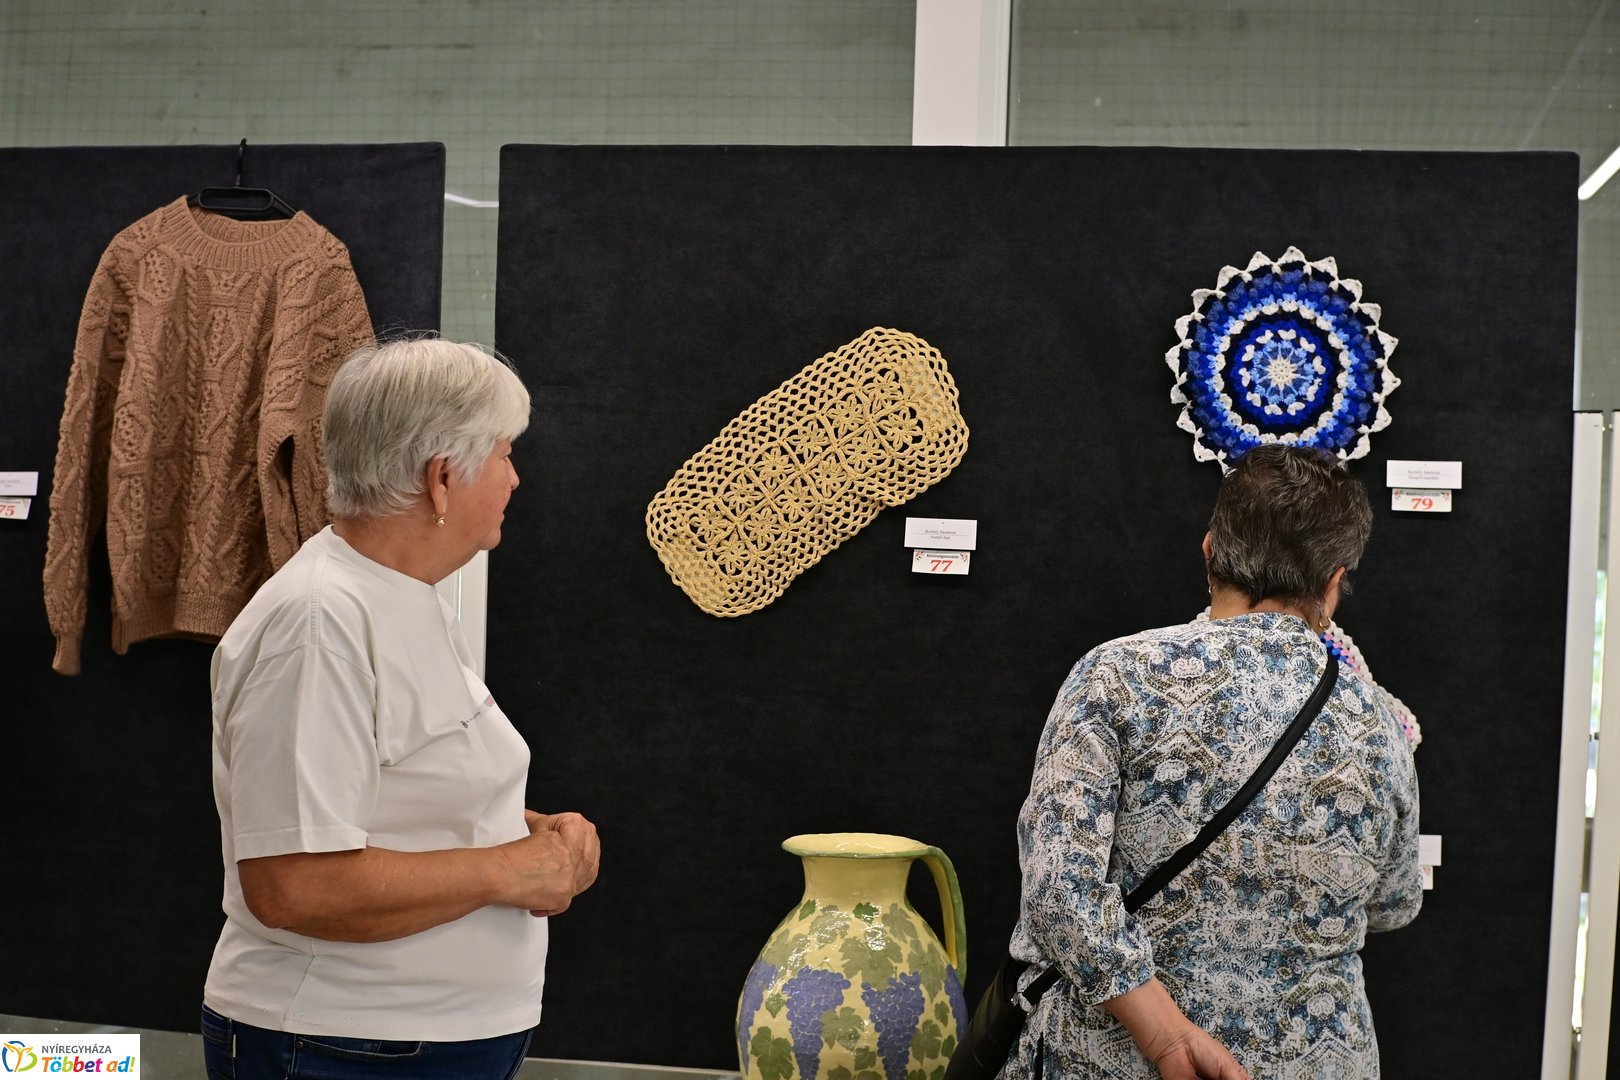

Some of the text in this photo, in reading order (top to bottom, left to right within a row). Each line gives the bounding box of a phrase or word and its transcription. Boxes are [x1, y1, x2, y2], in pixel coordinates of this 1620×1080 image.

[0, 504, 15, 517] 75
[1411, 498, 1434, 510] 79
[930, 559, 953, 572] 77
